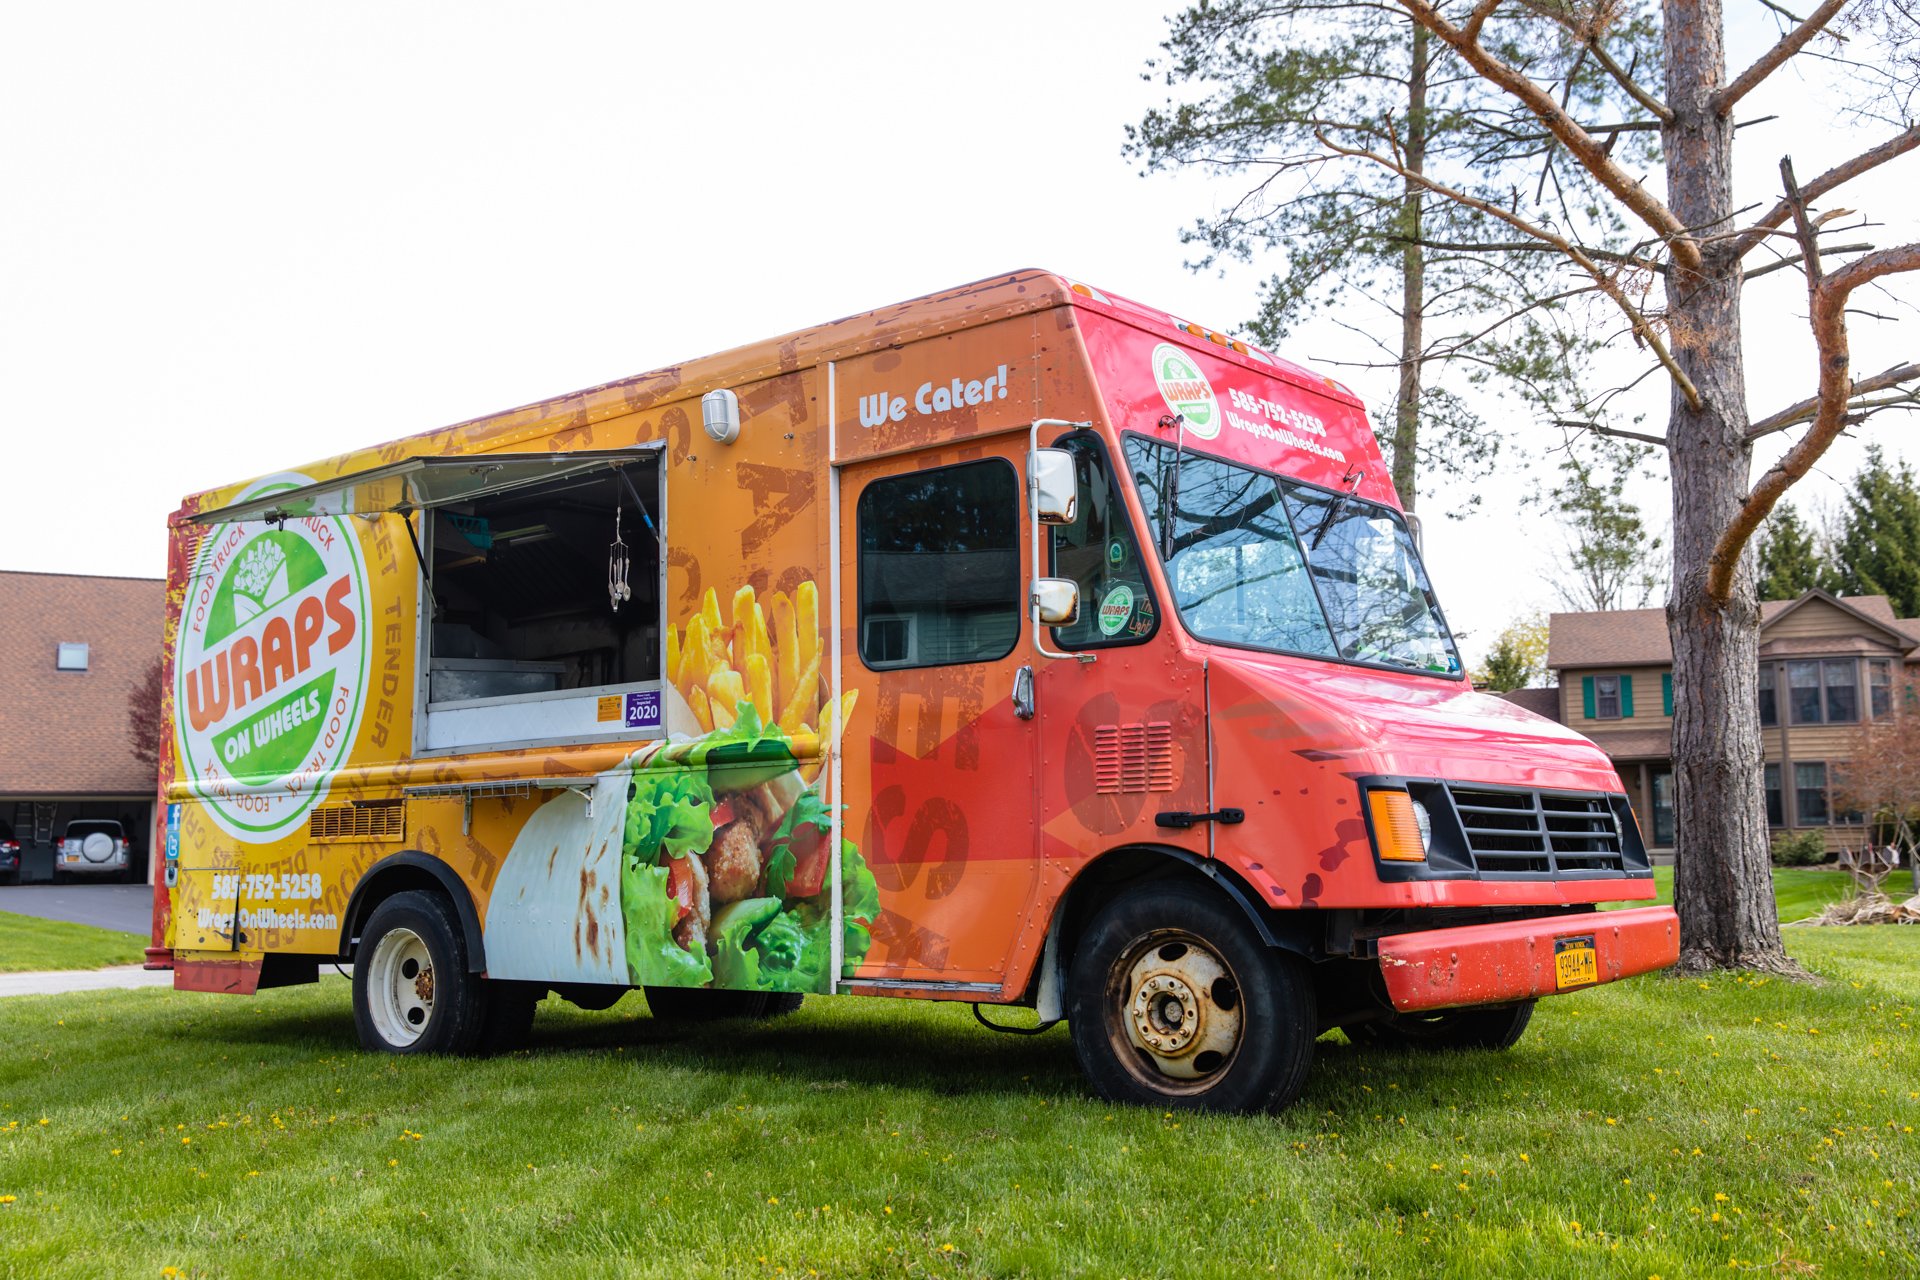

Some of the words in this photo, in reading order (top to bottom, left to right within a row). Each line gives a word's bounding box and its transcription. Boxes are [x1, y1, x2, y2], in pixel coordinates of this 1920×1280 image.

[859, 391, 907, 428] We
[915, 364, 1008, 415] Cater!
[1161, 381, 1211, 401] WRAPS
[1228, 387, 1327, 438] 585-752-5258
[1225, 410, 1346, 464] WrapsOnWheels.com
[193, 575, 215, 633] FOOD
[211, 521, 246, 573] TRUCK
[1102, 605, 1130, 616] WRAPS
[186, 573, 356, 732] WRAPS
[370, 595, 402, 750] TENDER
[224, 728, 251, 764] ON
[253, 689, 321, 749] WHEELS
[323, 686, 350, 749] FOOD
[629, 704, 658, 720] 2020
[284, 751, 327, 798] TRUCK
[235, 792, 270, 813] FOOD
[211, 873, 322, 900] 585-752-5258
[197, 908, 338, 933] WrapsOnWheels.com
